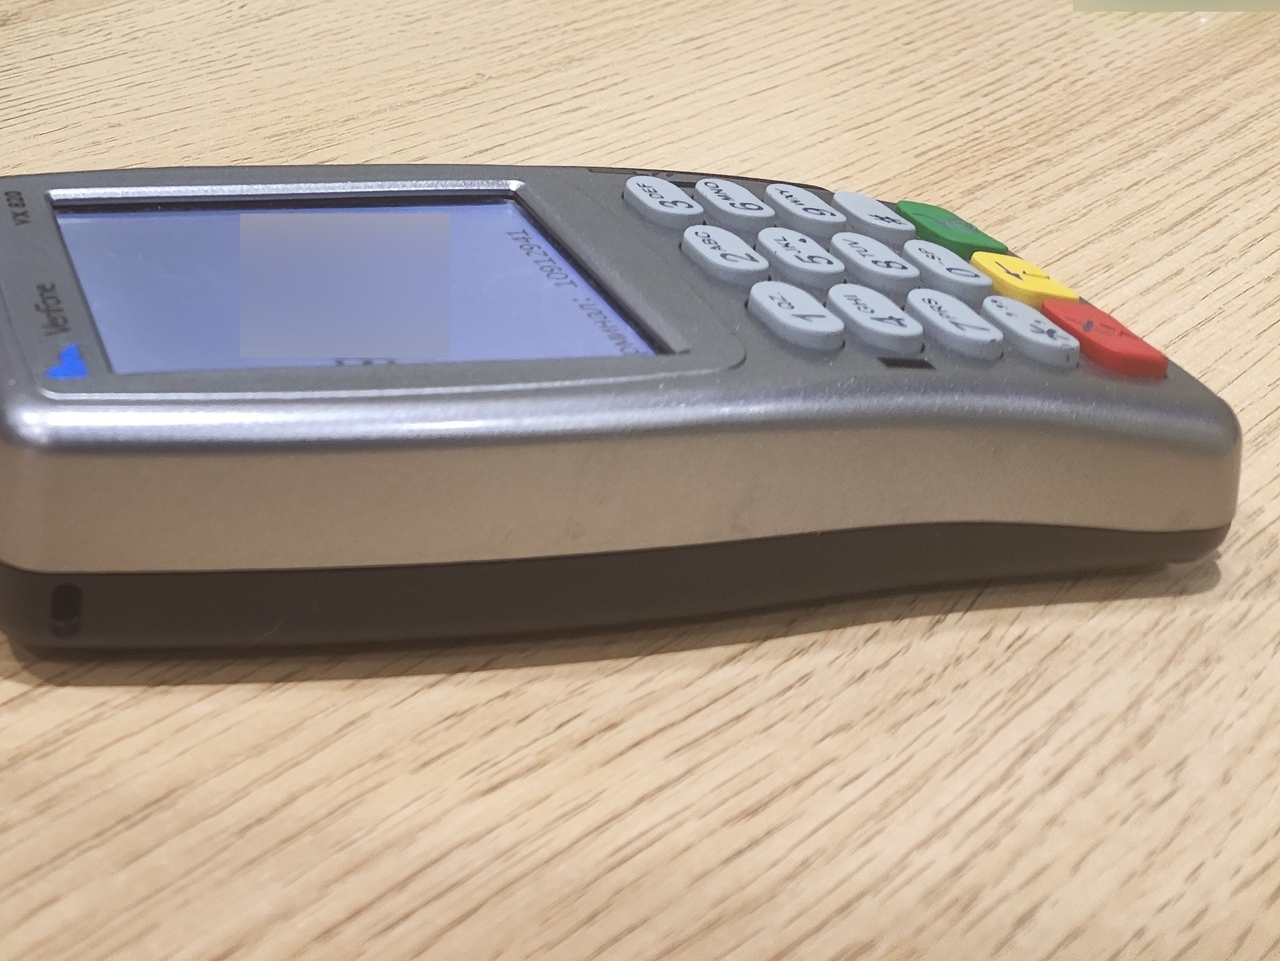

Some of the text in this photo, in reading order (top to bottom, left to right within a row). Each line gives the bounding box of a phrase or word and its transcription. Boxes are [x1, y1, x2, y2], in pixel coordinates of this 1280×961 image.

[659, 200, 694, 210] 3
[732, 202, 764, 212] 6
[720, 248, 760, 264] 2
[795, 253, 834, 266] 5
[871, 259, 908, 270] 8
